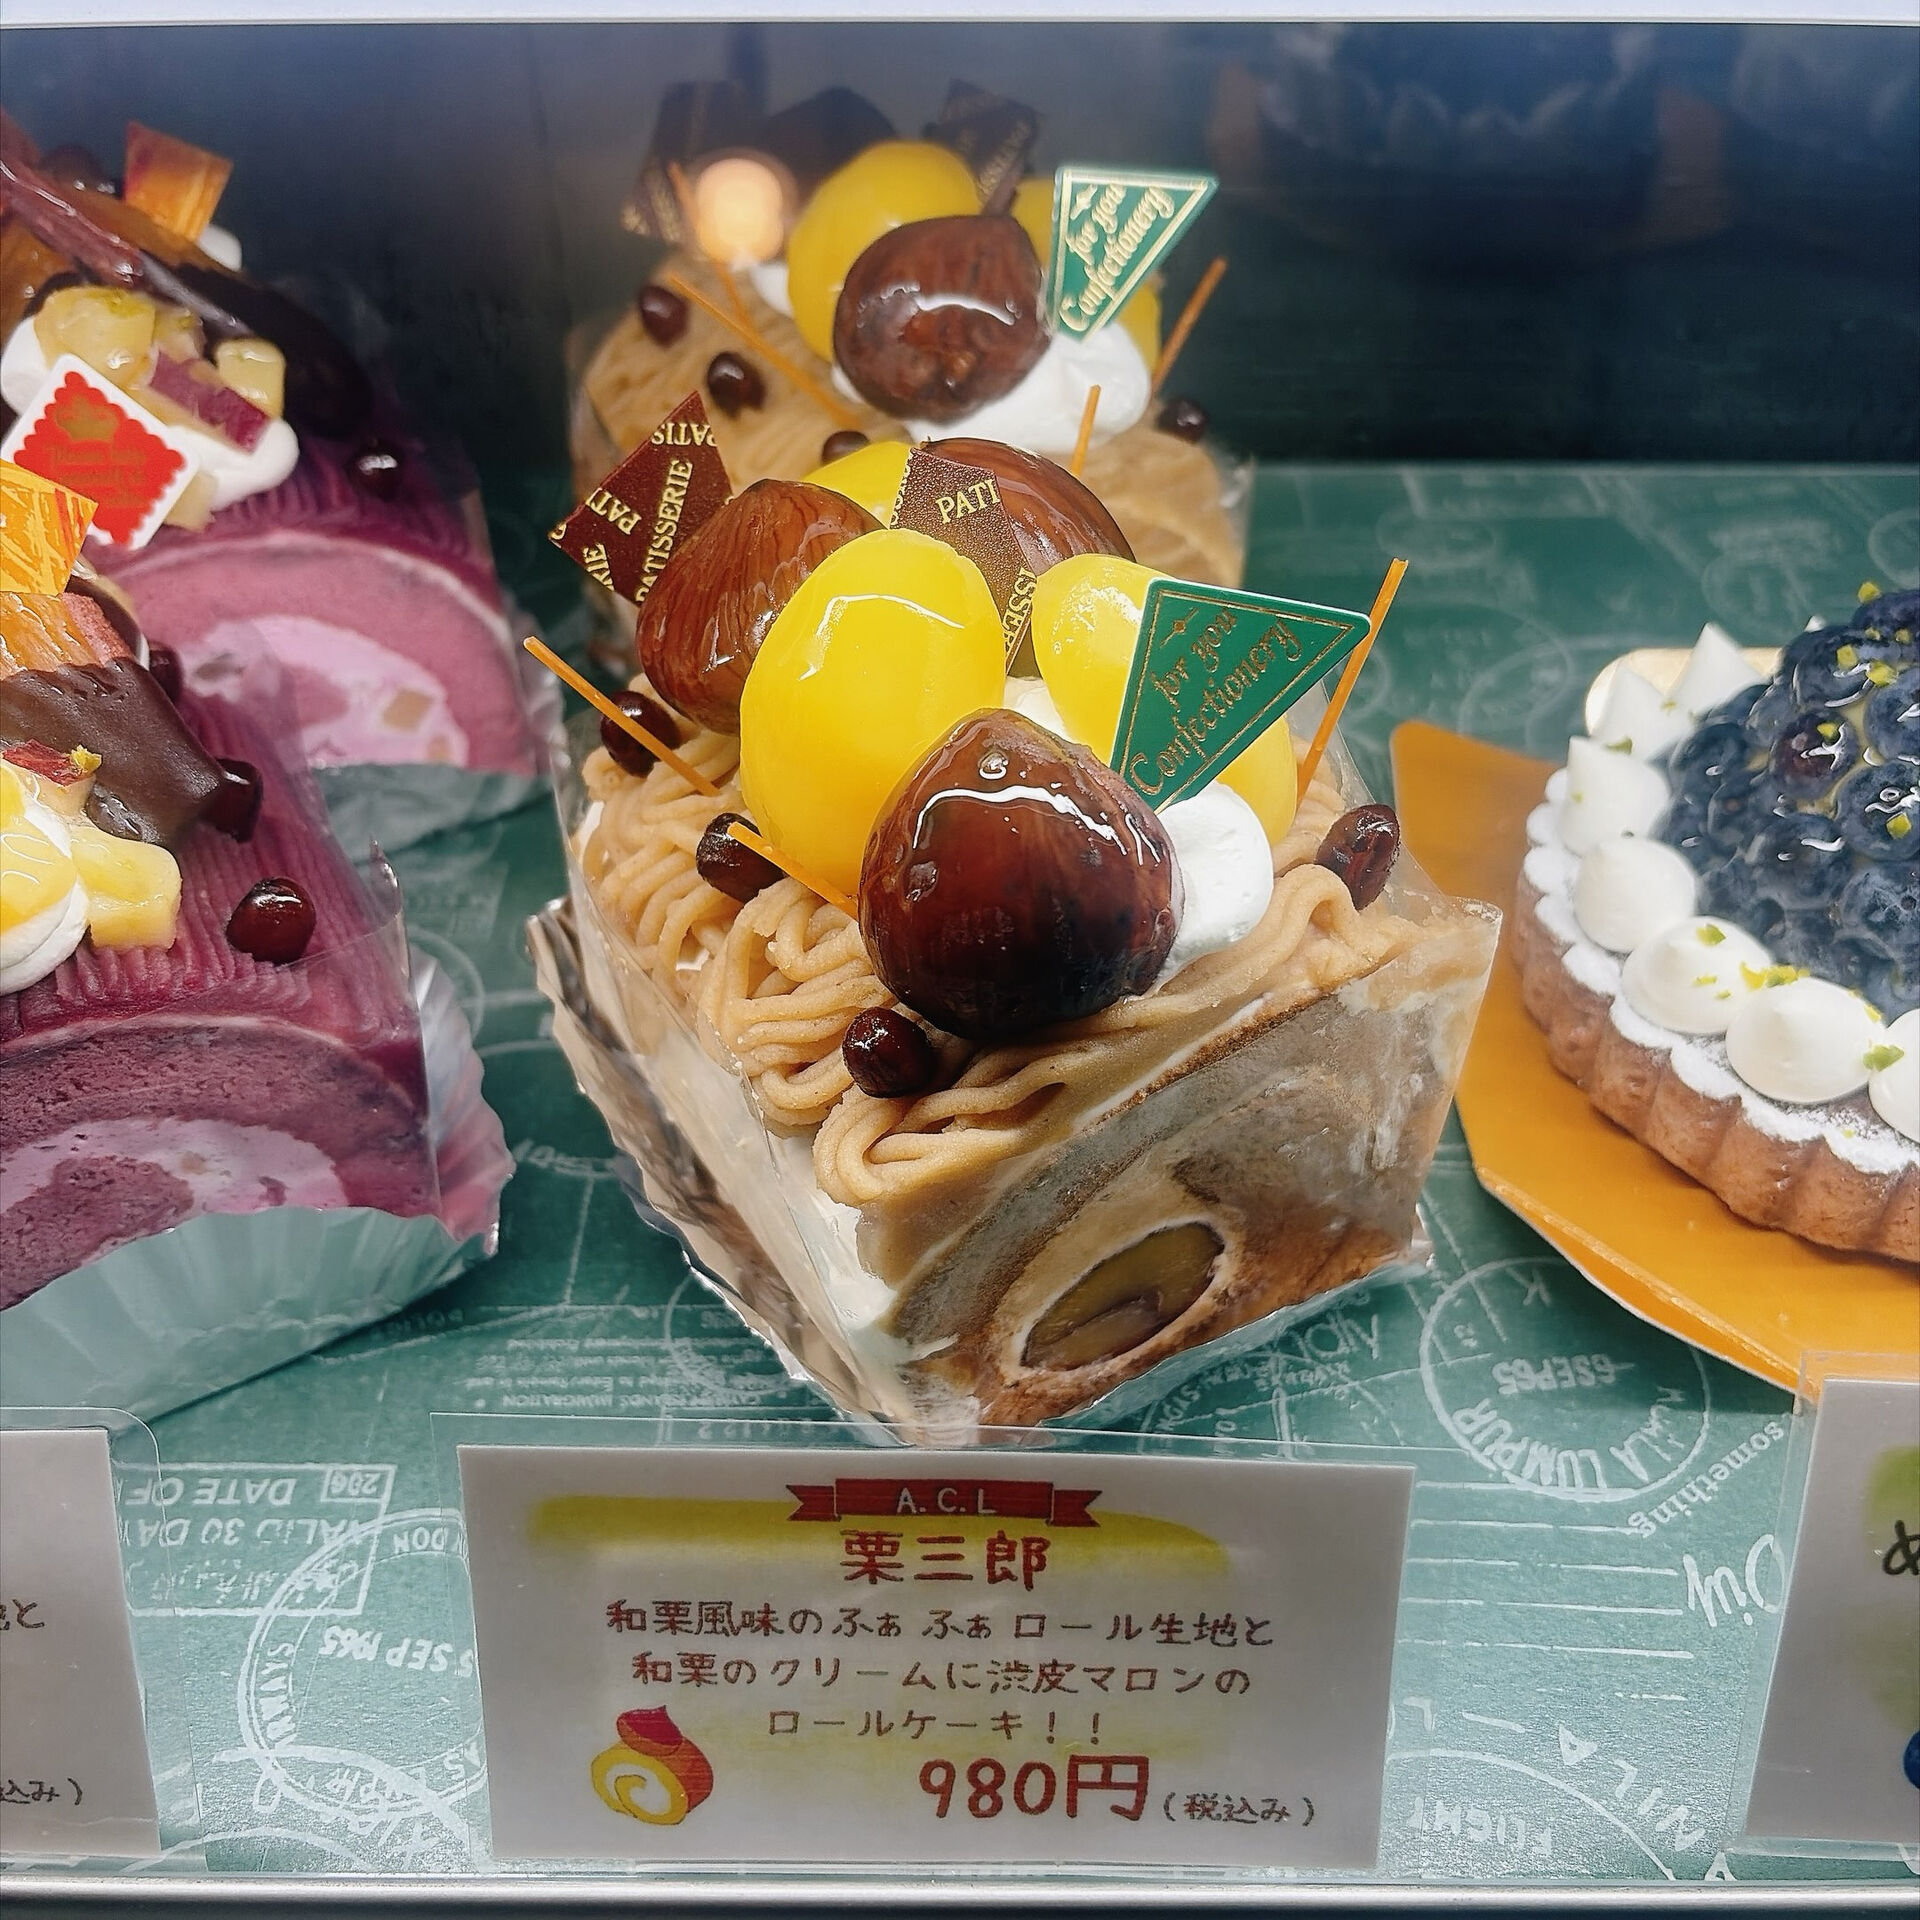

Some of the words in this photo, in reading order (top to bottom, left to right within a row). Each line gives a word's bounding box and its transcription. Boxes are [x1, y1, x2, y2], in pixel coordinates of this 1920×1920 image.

[1059, 187, 1173, 328] Confectionery
[1148, 653, 1194, 712] for
[1190, 605, 1236, 673] you
[1130, 617, 1300, 794] Confectionery
[1451, 1398, 1607, 1490] LUMPUR
[124, 1475, 185, 1508] OF
[194, 1477, 298, 1506] DATE
[896, 1487, 997, 1515] A.C.L
[1626, 1418, 1785, 1538] something
[199, 1517, 246, 1547] 30
[839, 1528, 1051, 1592] 栗三郎
[385, 1637, 454, 1674] SEP
[632, 1650, 1252, 1695] 和栗のクリームに渋皮マロンの
[919, 1753, 1149, 1822] 980円
[1162, 1791, 1315, 1827] (税込み)
